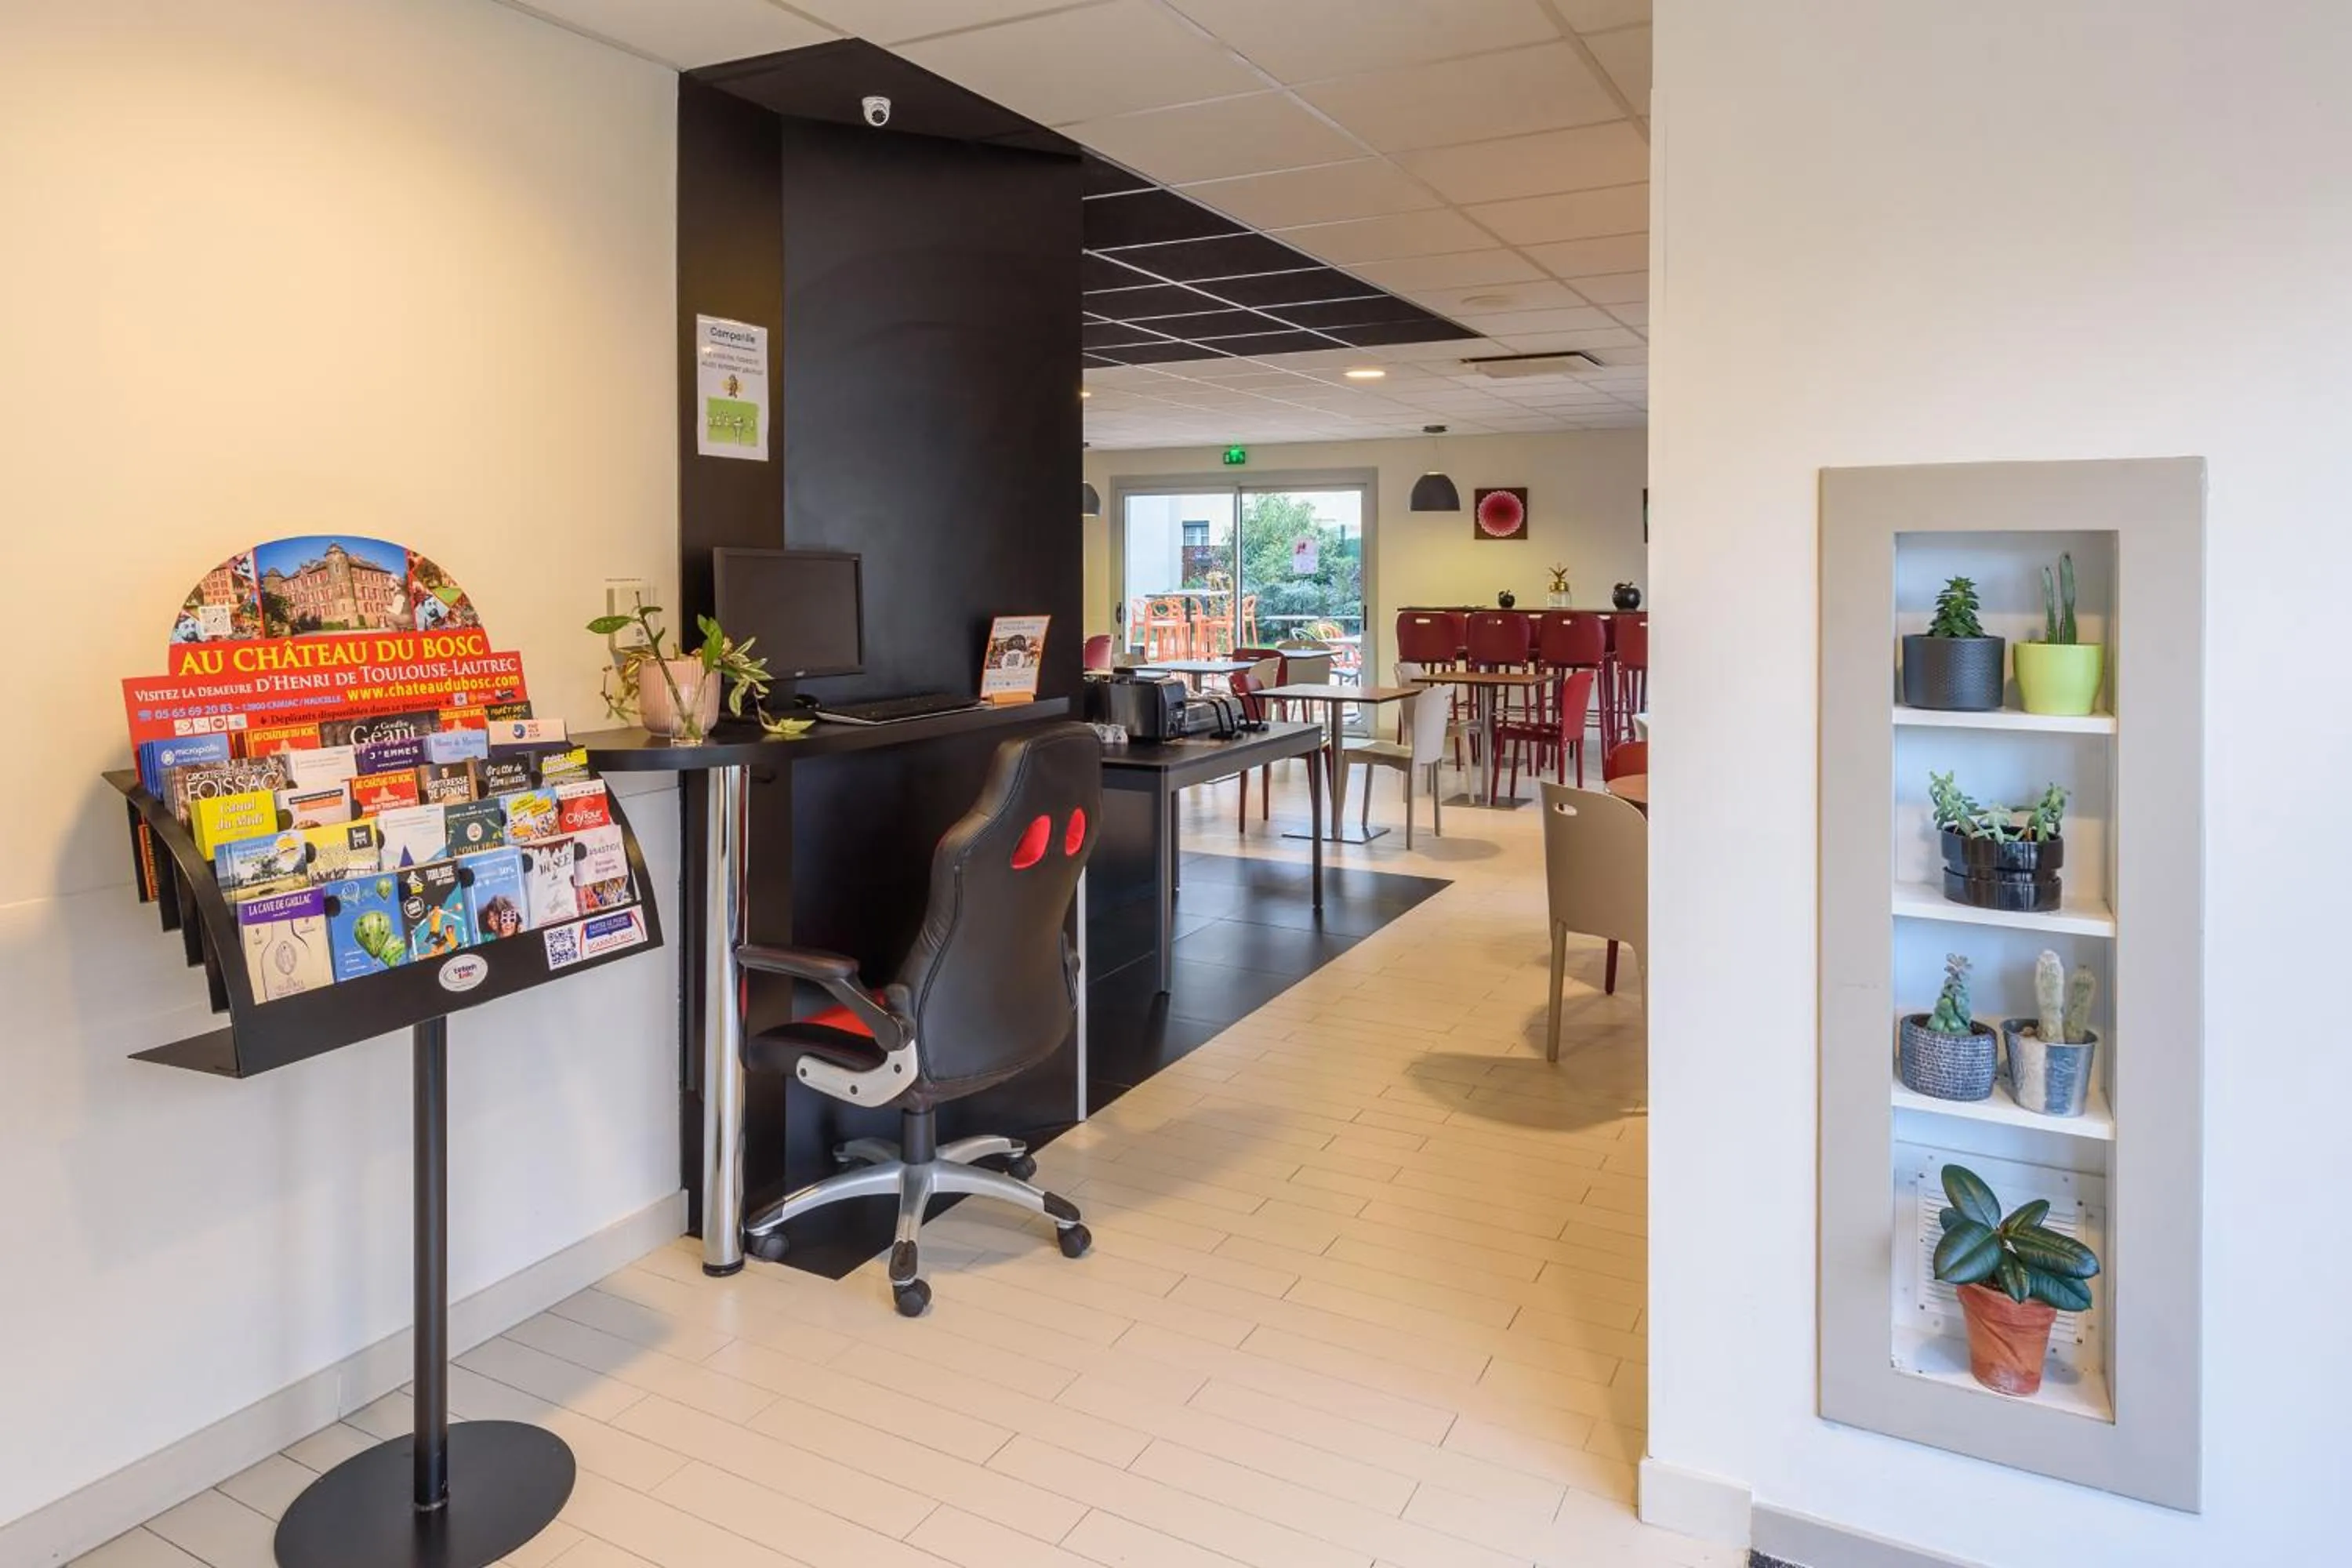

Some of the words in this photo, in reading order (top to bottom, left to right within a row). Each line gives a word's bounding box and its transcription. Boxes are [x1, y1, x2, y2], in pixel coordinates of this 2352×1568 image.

[179, 649, 224, 677] AU
[233, 640, 368, 672] CHÂTEAU
[376, 638, 415, 662] DU
[423, 634, 485, 659] BOSC
[134, 689, 180, 702] VISITEZ
[181, 688, 196, 699] LA
[198, 683, 252, 698] DEMEURE
[256, 672, 330, 693] D'HENRI
[336, 672, 357, 686] DE
[358, 657, 517, 684] TOULOUSE-LAUTREC
[347, 674, 520, 702] www.chateaudubosc.com
[155, 707, 169, 719] 05
[172, 706, 186, 718] 65
[188, 706, 201, 717] 69
[350, 724, 417, 749] Géant
[187, 771, 280, 802] FOISSAC
[248, 906, 258, 916] LA
[258, 901, 275, 914] CAVE
[275, 899, 285, 909] DE
[285, 893, 313, 909] GAILLAC
